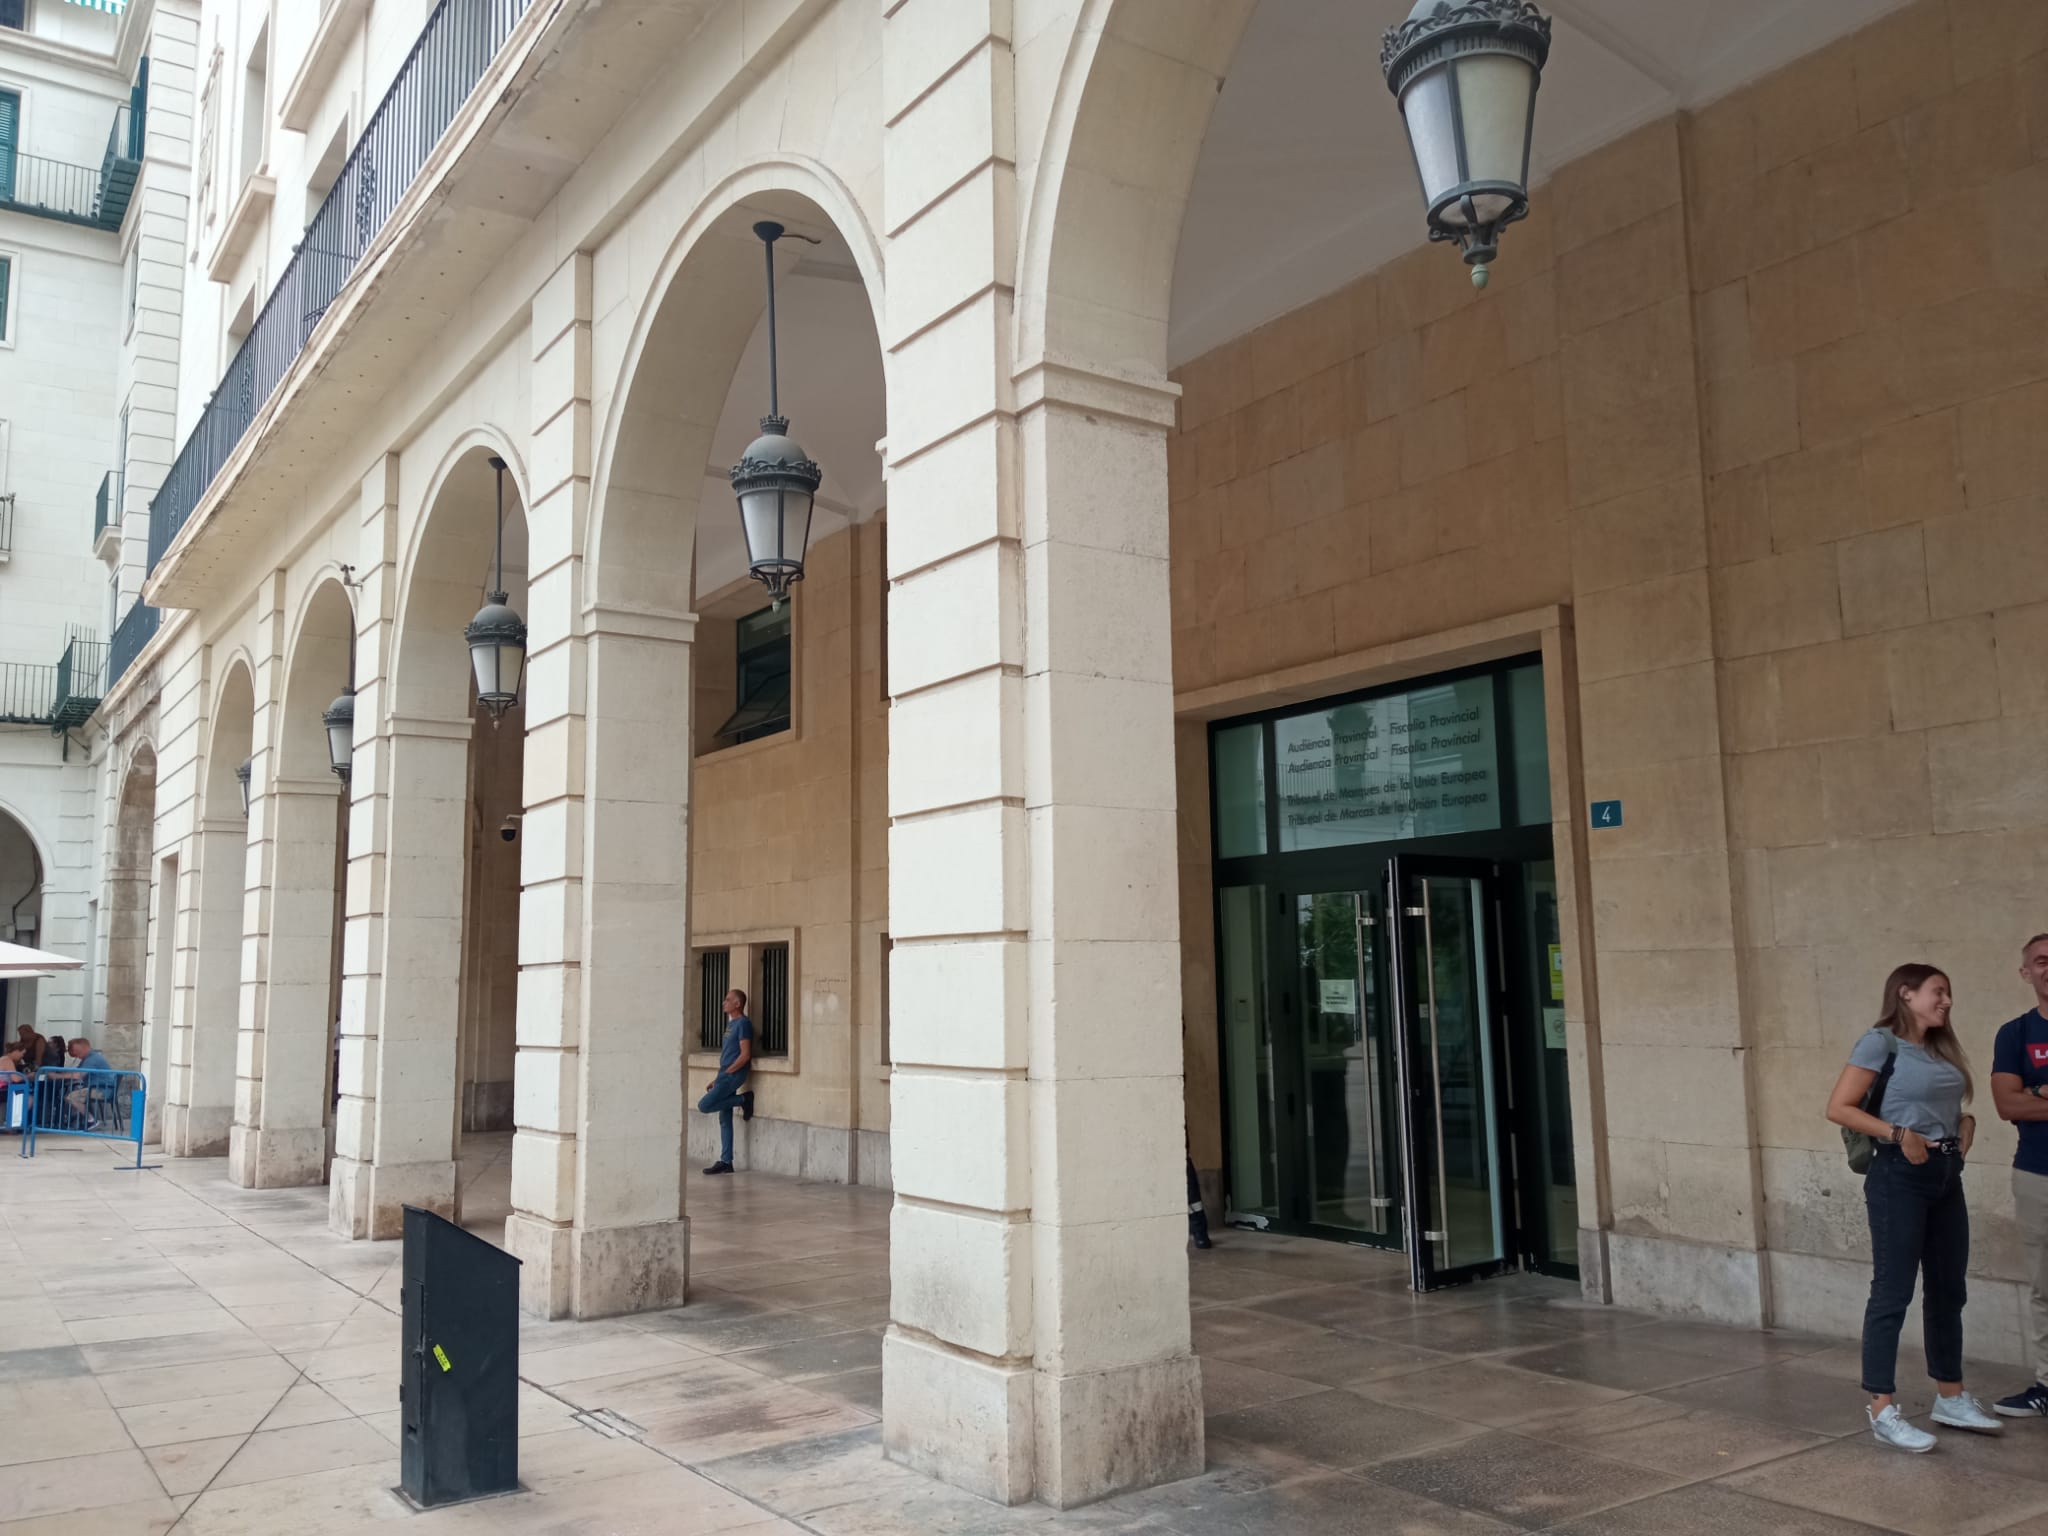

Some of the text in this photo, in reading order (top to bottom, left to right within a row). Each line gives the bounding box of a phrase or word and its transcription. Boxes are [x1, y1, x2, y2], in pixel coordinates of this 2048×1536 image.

[1333, 726, 1377, 744] Provincial
[1430, 706, 1479, 728] Provincial
[1334, 746, 1378, 767] Provincial
[1431, 728, 1480, 749] Provincial
[1323, 789, 1336, 801] de
[1383, 779, 1397, 792] de
[1440, 770, 1486, 785] Europea
[1324, 808, 1338, 821] de
[1339, 808, 1376, 821] Marcas
[1378, 801, 1392, 815] de
[1394, 800, 1407, 813] la
[1441, 793, 1487, 808] Europea
[1602, 805, 1611, 823] 4
